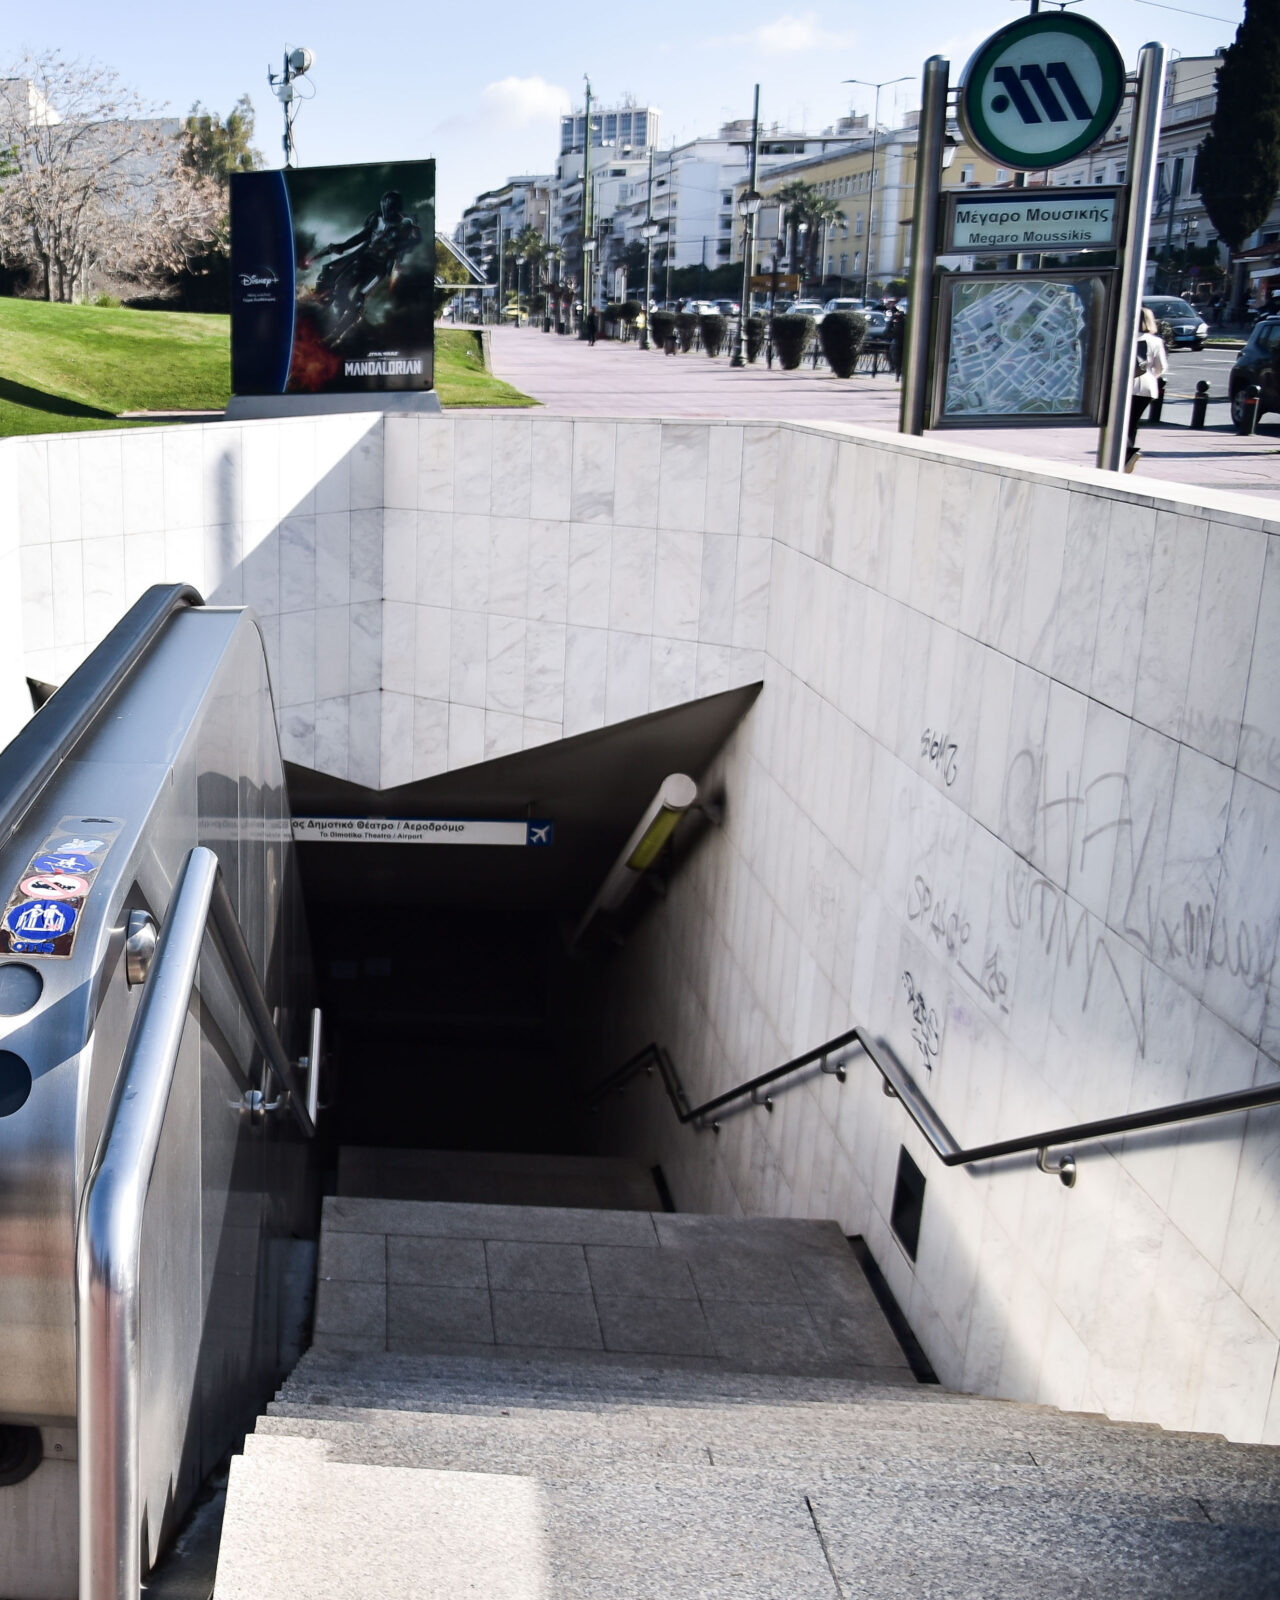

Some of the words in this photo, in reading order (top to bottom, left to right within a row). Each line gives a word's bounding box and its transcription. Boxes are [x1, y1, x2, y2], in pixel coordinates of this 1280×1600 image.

[956, 210, 1020, 226] Μέγαρο
[1026, 206, 1110, 223] Μουσικής
[969, 232, 1019, 246] Megaro
[1023, 230, 1092, 242] Moussikis
[344, 360, 423, 377] MANDALORIAN
[307, 819, 354, 830] Δημοτικό
[357, 820, 394, 831] Θέατρο
[402, 822, 465, 833] Αεροδρόμιο
[13, 941, 55, 953] OTIS
